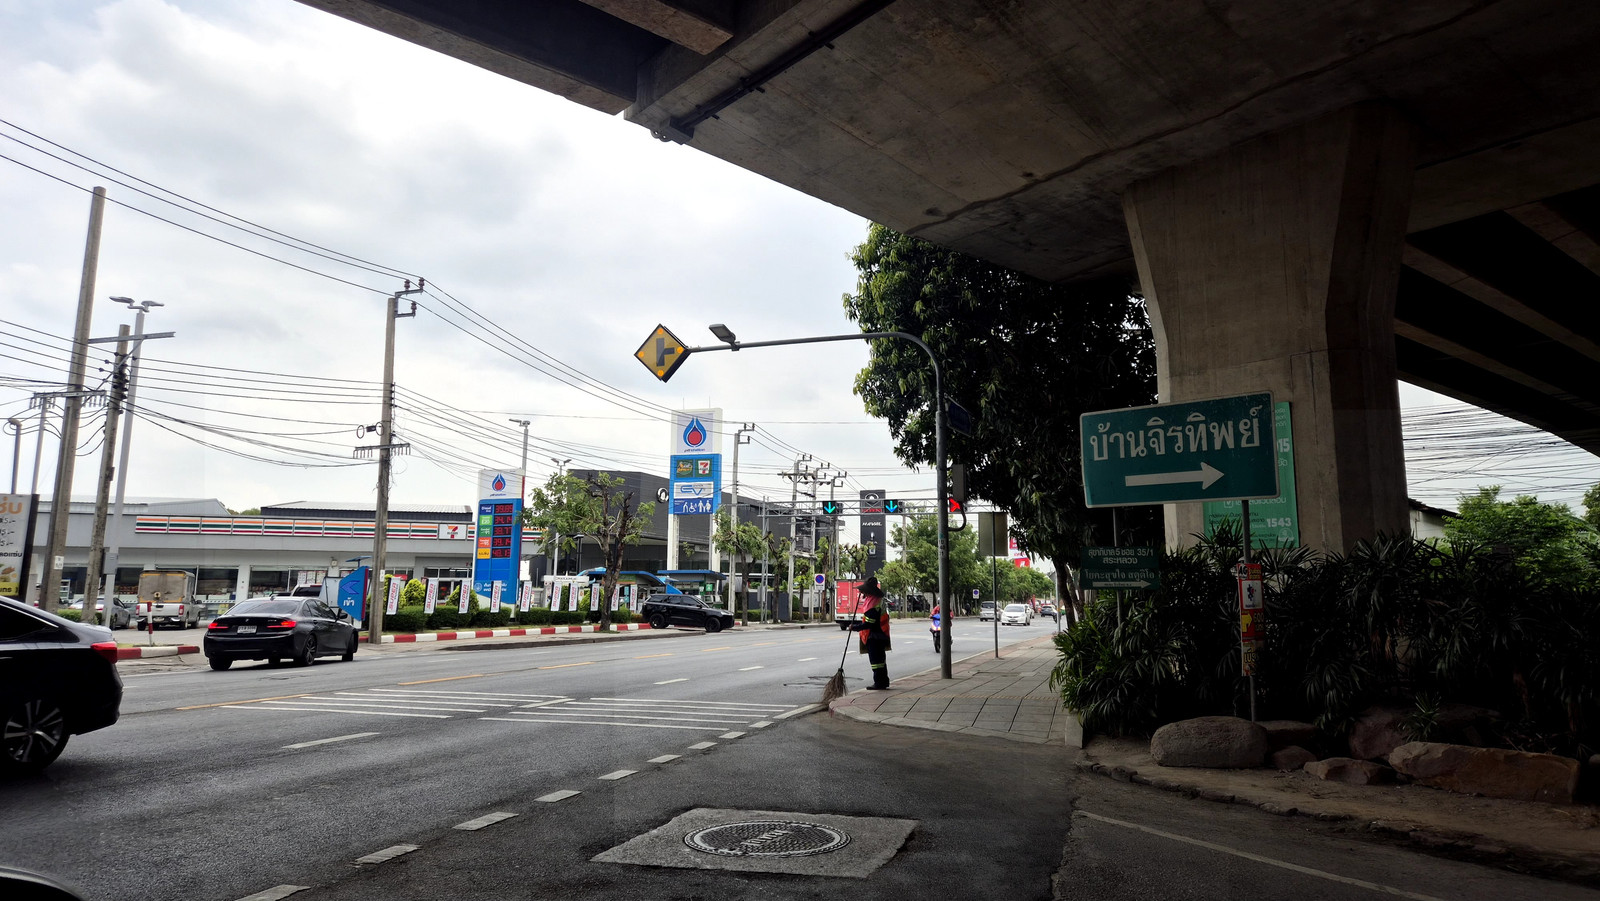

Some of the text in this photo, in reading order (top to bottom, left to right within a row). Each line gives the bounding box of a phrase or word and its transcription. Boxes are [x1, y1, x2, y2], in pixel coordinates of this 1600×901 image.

[1090, 405, 1263, 461] บ้านจิรทิพย์
[1266, 517, 1292, 528] 1543
[1137, 548, 1154, 557] 35/1
